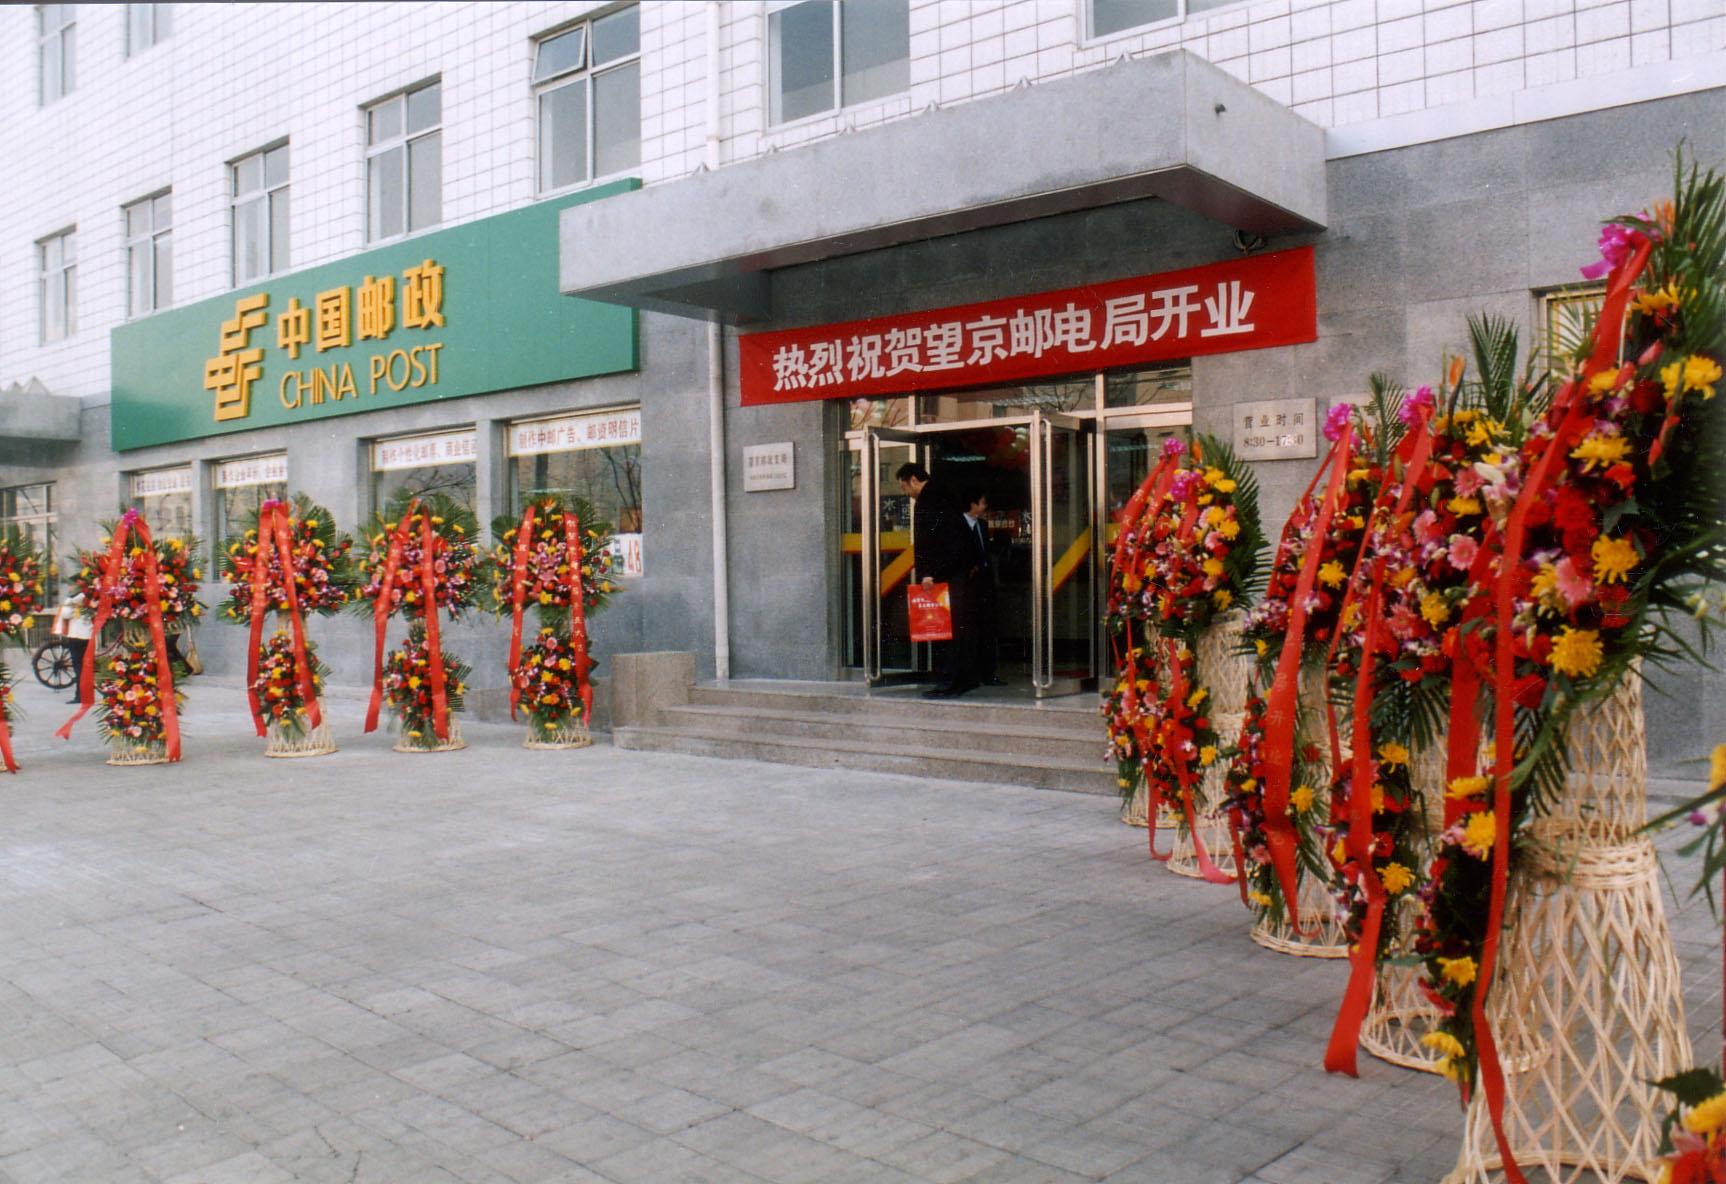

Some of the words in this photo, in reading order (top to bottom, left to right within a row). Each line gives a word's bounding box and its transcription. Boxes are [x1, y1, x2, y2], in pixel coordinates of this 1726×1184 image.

[276, 257, 446, 360] 中国邮政
[773, 280, 1255, 391] 热烈祝贺望京邮电局开业
[280, 361, 358, 410] CHINA
[370, 342, 444, 395] POST
